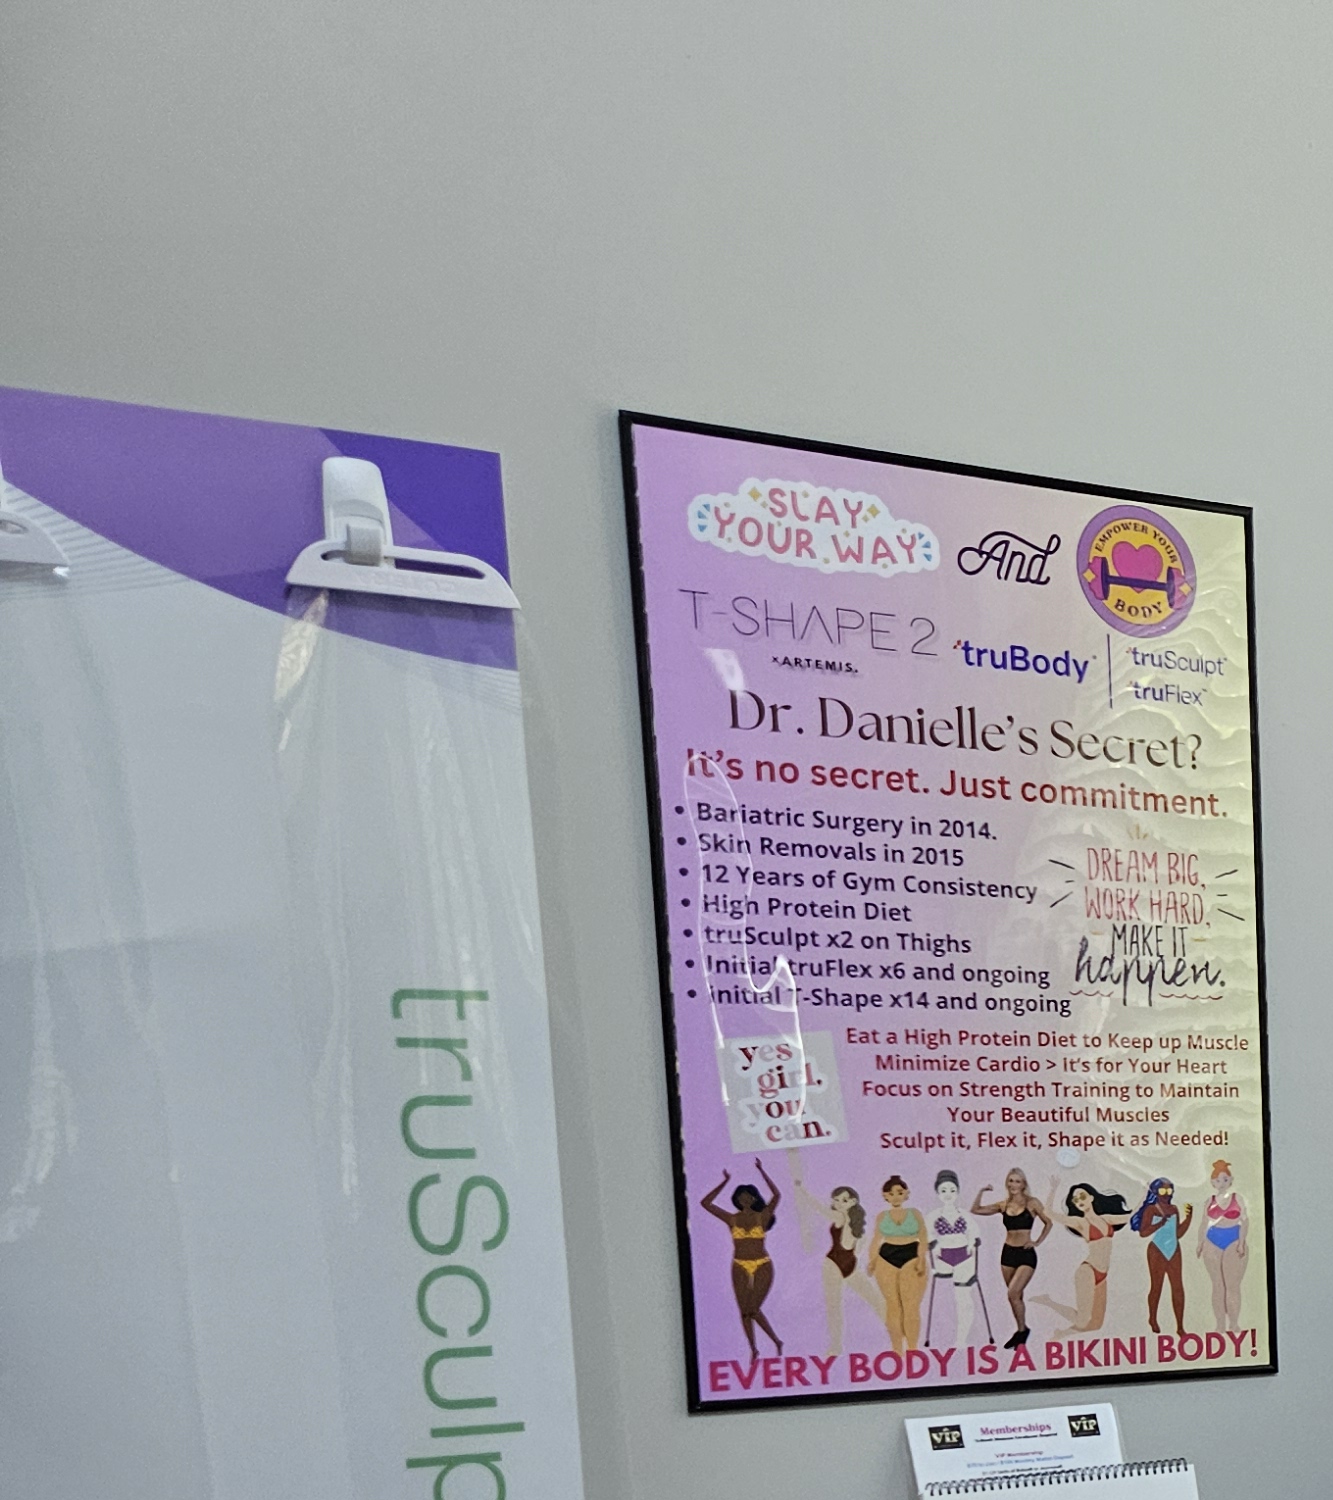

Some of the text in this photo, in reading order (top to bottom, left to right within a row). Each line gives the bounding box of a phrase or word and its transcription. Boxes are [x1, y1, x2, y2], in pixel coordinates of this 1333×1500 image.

[768, 488, 863, 528] SLAY
[714, 506, 917, 564] YOUR WAY
[1095, 522, 1178, 563] EMPOWER YOUR
[958, 531, 1061, 585] And
[1115, 598, 1162, 618] BODY
[910, 617, 937, 655] 2
[730, 689, 803, 734] Dr.
[1050, 720, 1201, 770] Secret?
[756, 760, 799, 784] no
[811, 764, 929, 794] secret.
[940, 770, 1011, 800] Just
[1021, 783, 1227, 818] commitment.
[697, 802, 997, 840] Bariatric Surgery in 2014.
[699, 833, 963, 867] Skin Removals in 2015
[702, 864, 1037, 904] 12 Years of Gym Consistency
[1086, 847, 1206, 891] DREAM BIG,
[703, 895, 912, 923] High Protein Diet
[1084, 886, 1210, 928] WORK HARD,
[705, 926, 972, 957] truSculpt x2 on Thighs
[1112, 924, 1188, 957] MAKE IT
[1075, 935, 1226, 1006] happen.
[738, 1042, 793, 1071] yes
[847, 1028, 1249, 1052] Eat a High Protein Diet to Keep up Muscle
[757, 1063, 823, 1099] girl.
[875, 1055, 1227, 1074] Minimize Cardio > It's for Your Heart
[862, 1081, 1239, 1101] Focus on Strength Training to Maintain
[746, 1098, 806, 1127] you
[947, 1107, 1170, 1122] Your Beautiful Muscles
[766, 1120, 832, 1142] can.
[880, 1131, 1229, 1152] Sculpt it, Flex it, Shape it as Needed!
[708, 1328, 1258, 1393] EVERY BODY IS A BIKINI BODY!
[932, 1431, 961, 1443] VIP
[980, 1423, 1051, 1435] Memberships
[1071, 1420, 1097, 1431] VIP
